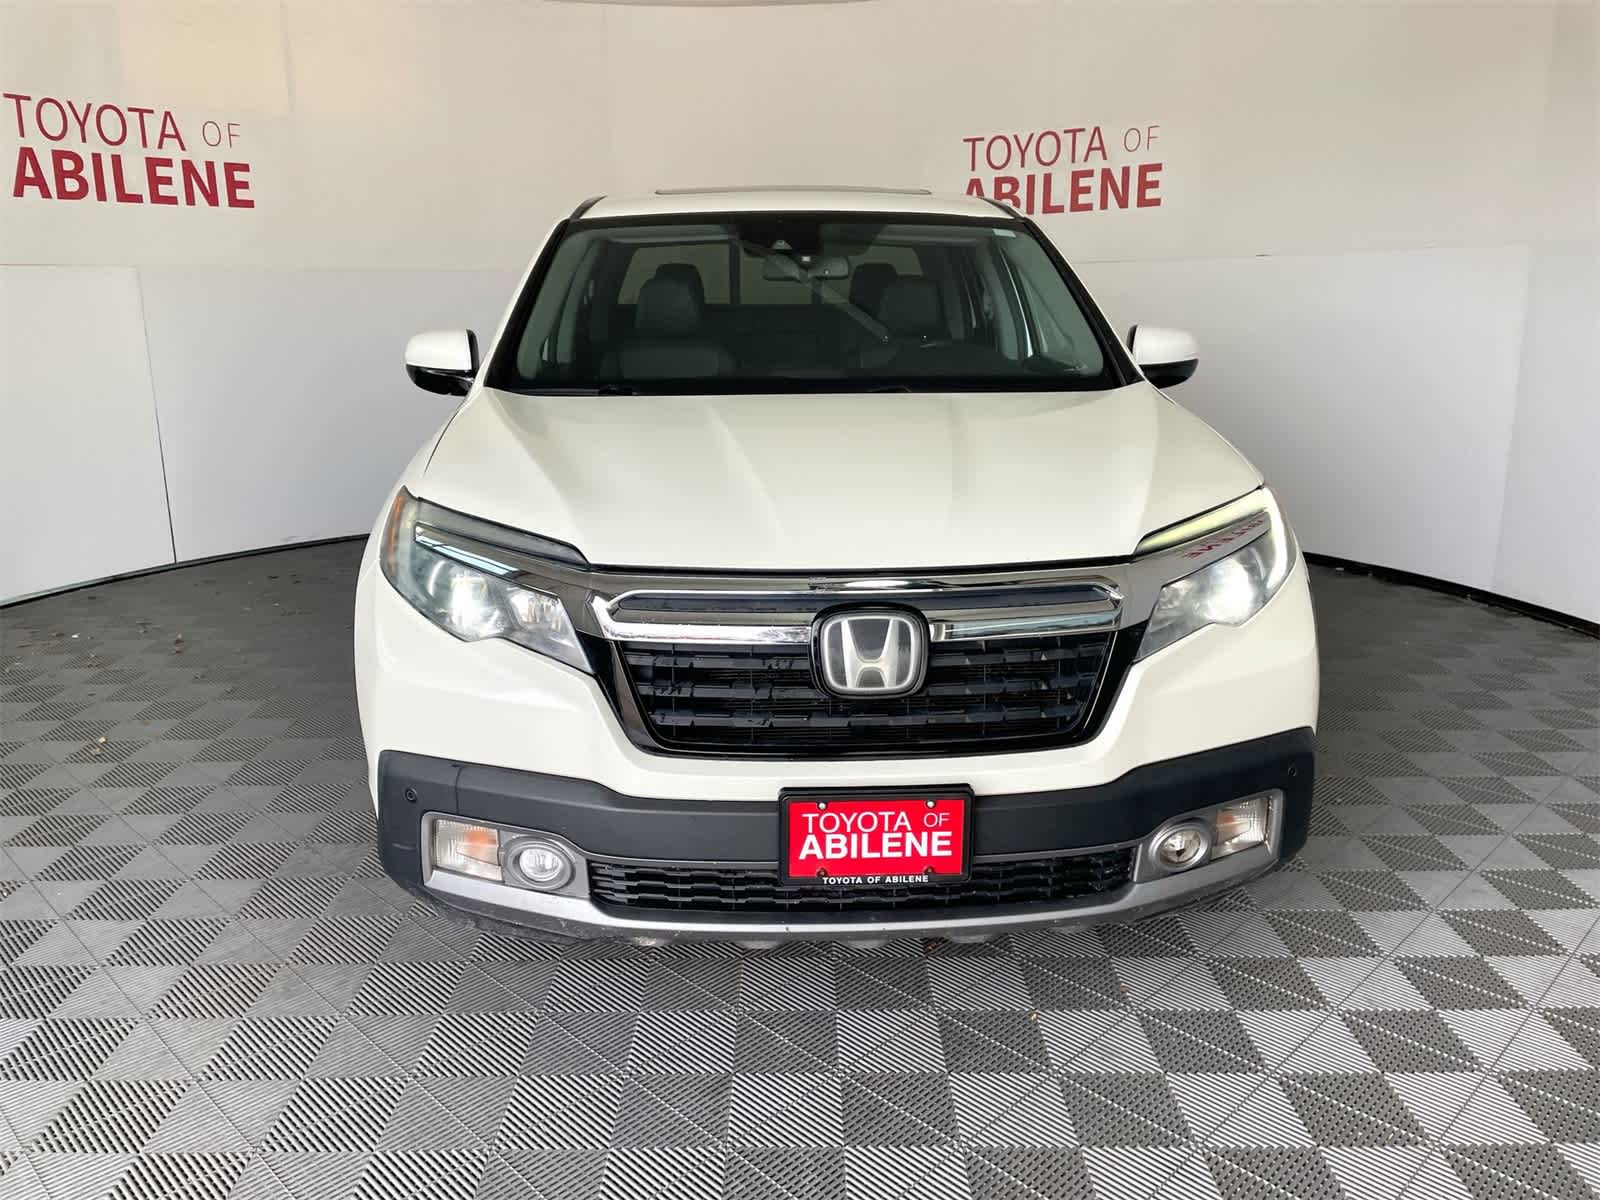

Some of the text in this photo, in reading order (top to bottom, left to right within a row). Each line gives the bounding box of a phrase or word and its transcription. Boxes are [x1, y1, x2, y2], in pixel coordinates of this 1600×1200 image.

[3, 93, 241, 151] TOYOTA OF
[963, 125, 1160, 172] TOYOTA OF
[13, 147, 255, 208] ABILENE
[802, 811, 950, 834] TOYOTA OF
[798, 831, 953, 861] ABILENE
[822, 875, 929, 885] TOYOTA OF ABILENE
